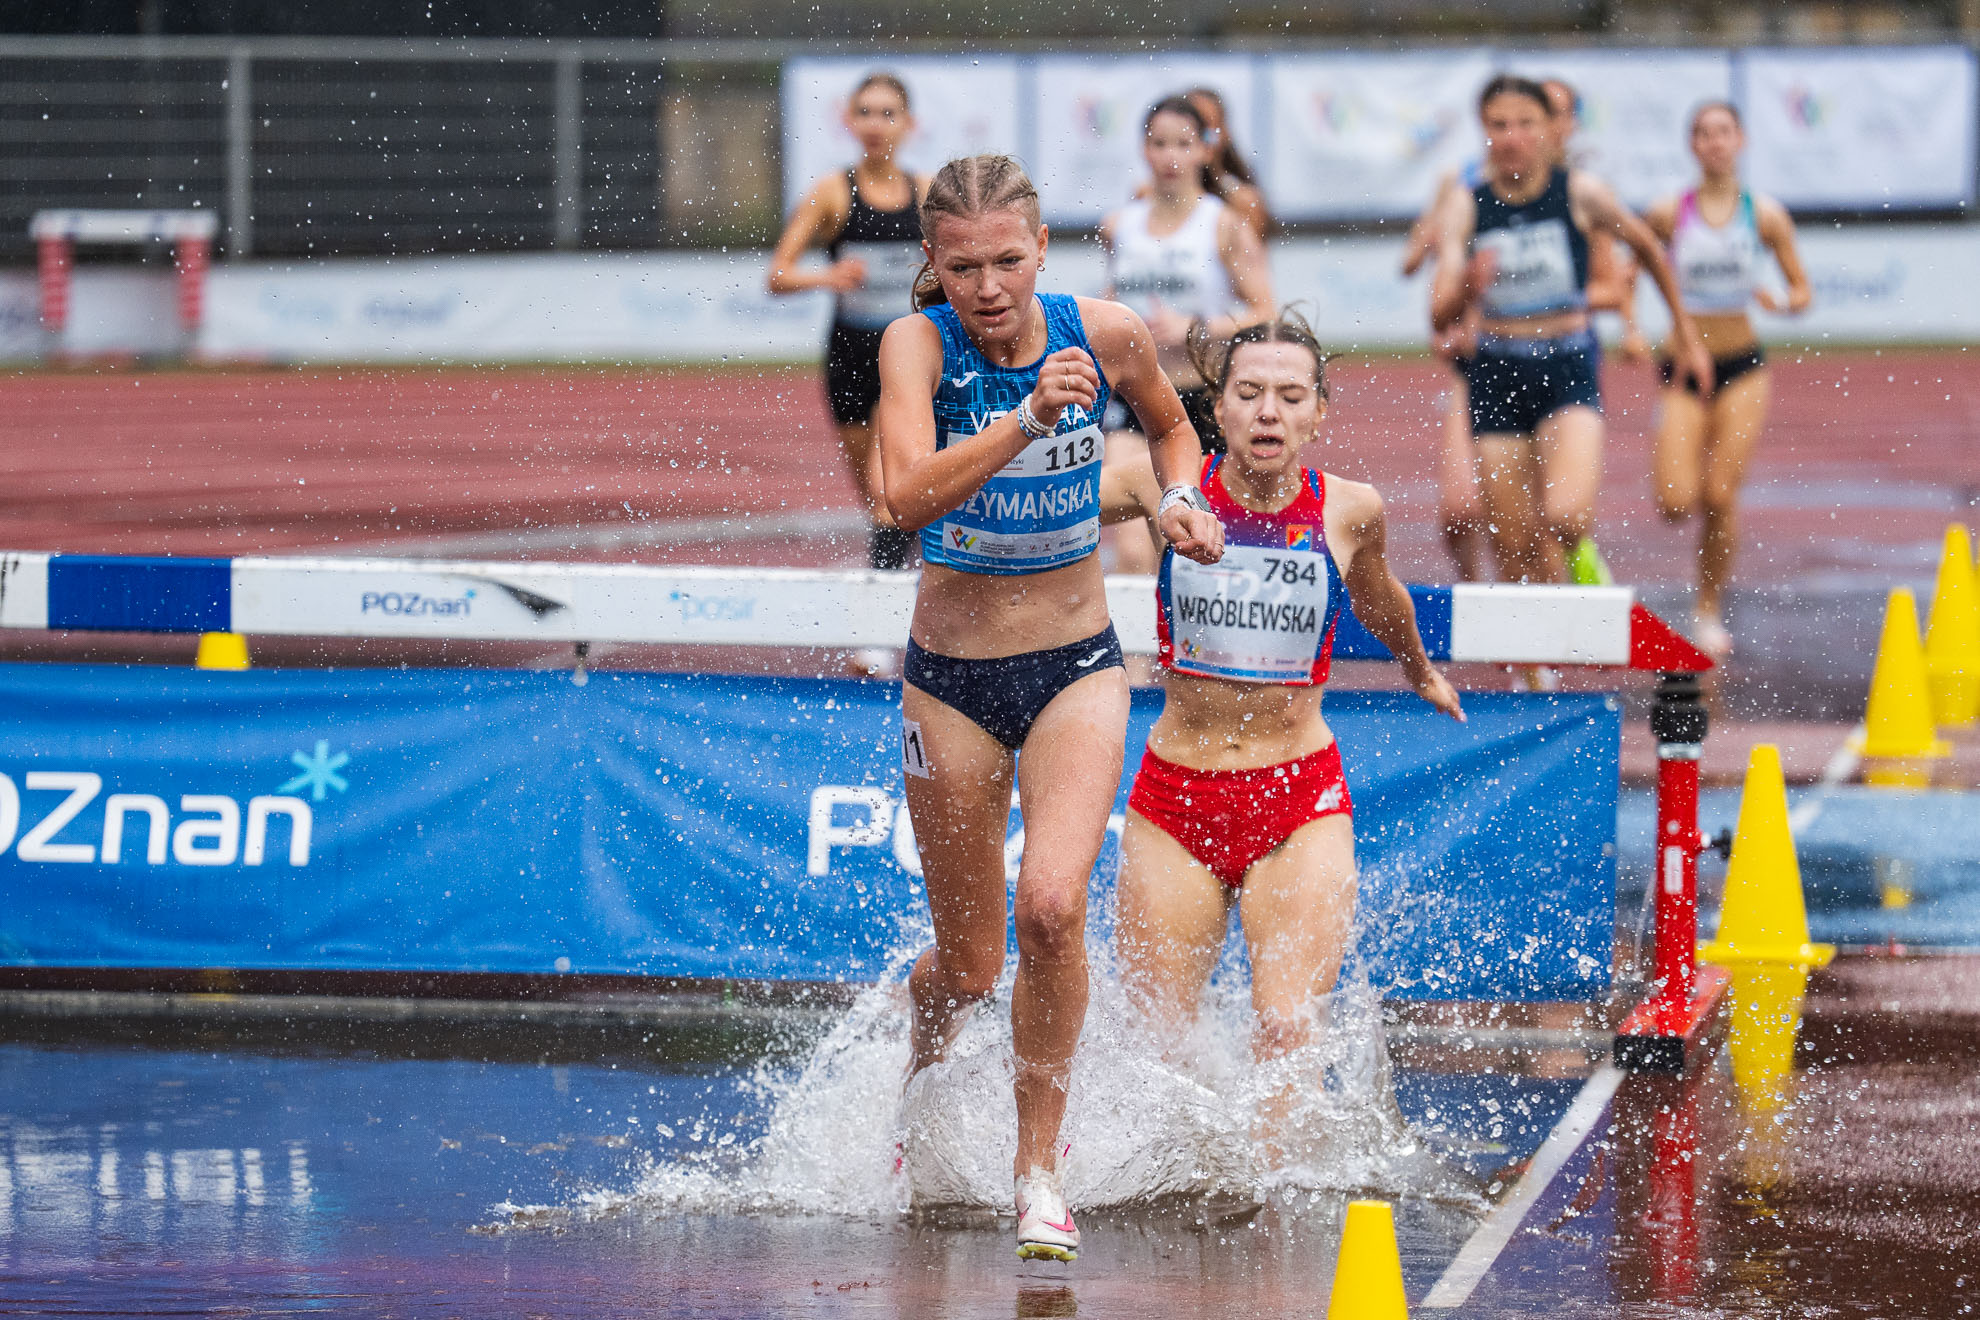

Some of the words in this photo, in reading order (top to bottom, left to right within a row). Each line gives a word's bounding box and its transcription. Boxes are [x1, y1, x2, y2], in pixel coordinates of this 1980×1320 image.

[969, 403, 1089, 434] VERA
[1045, 436, 1095, 472] 113
[955, 478, 1093, 521] ZYMAŃSKA
[1264, 558, 1316, 586] 784
[1177, 593, 1316, 634] WRÓBLEWSKA
